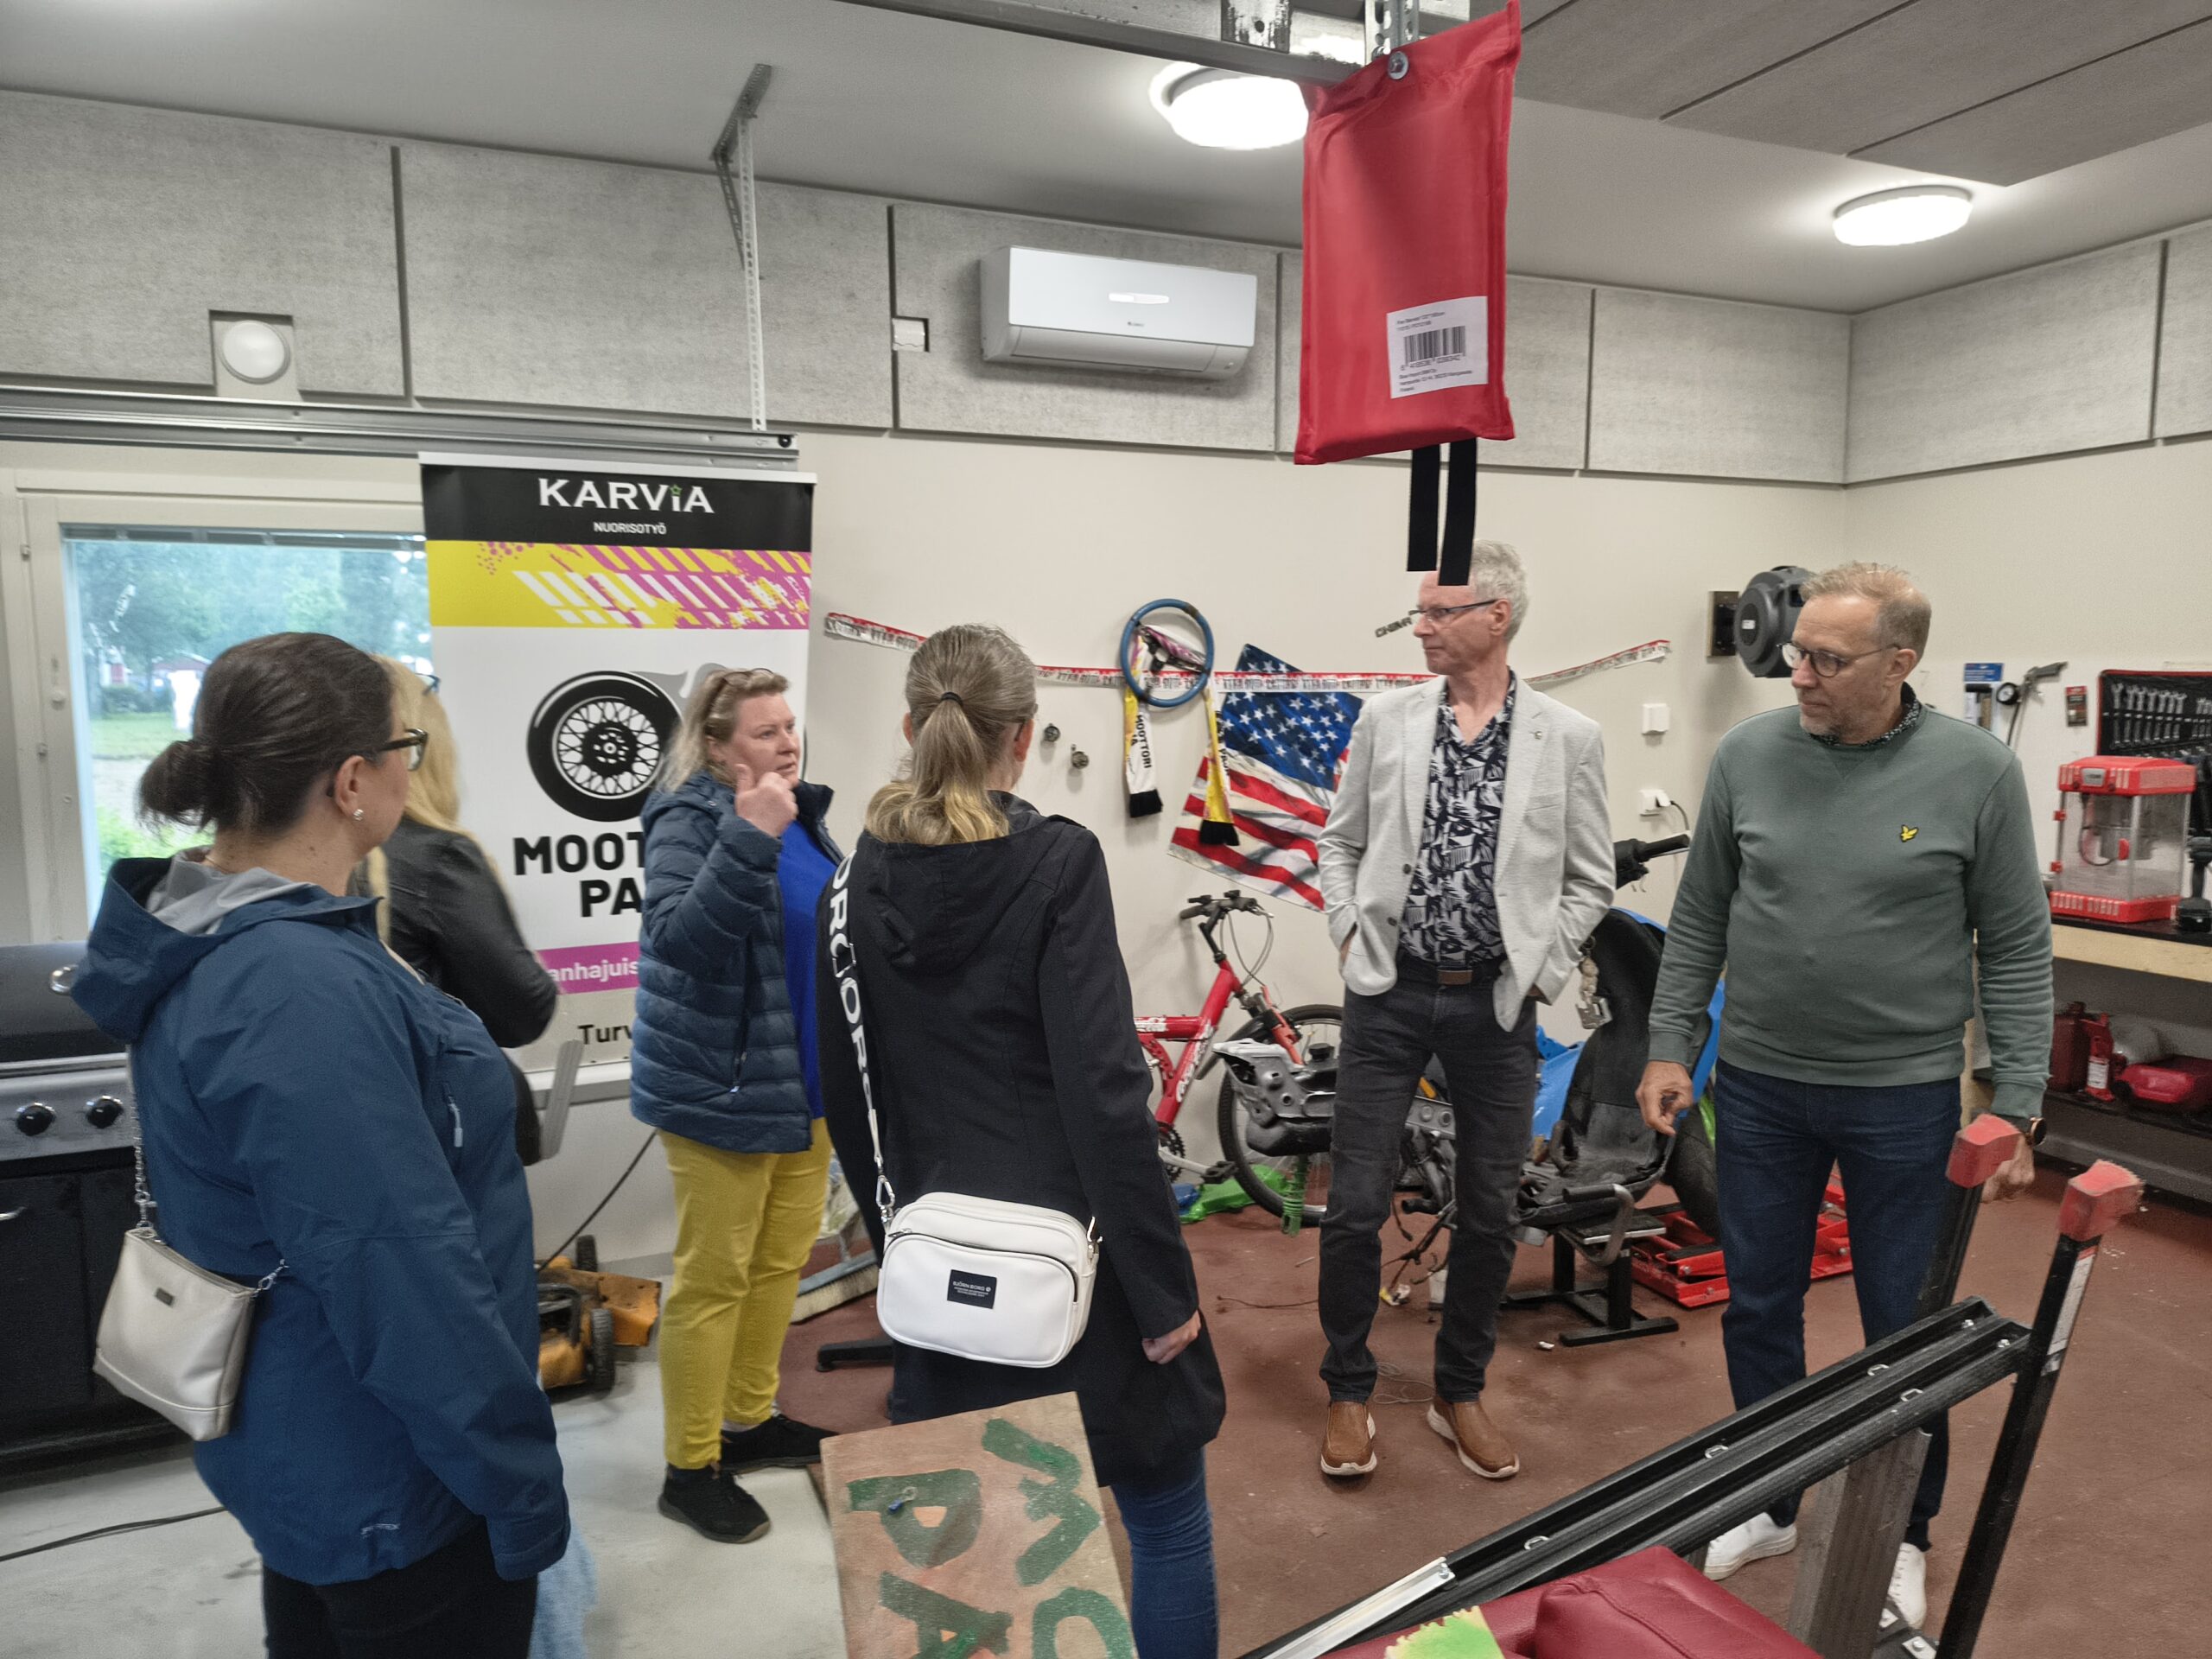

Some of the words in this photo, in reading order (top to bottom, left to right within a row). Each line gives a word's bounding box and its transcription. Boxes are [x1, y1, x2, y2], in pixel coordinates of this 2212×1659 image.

[593, 521, 667, 535] NUORISOTYÖ
[513, 831, 646, 875] MOOT
[580, 877, 643, 917] PA
